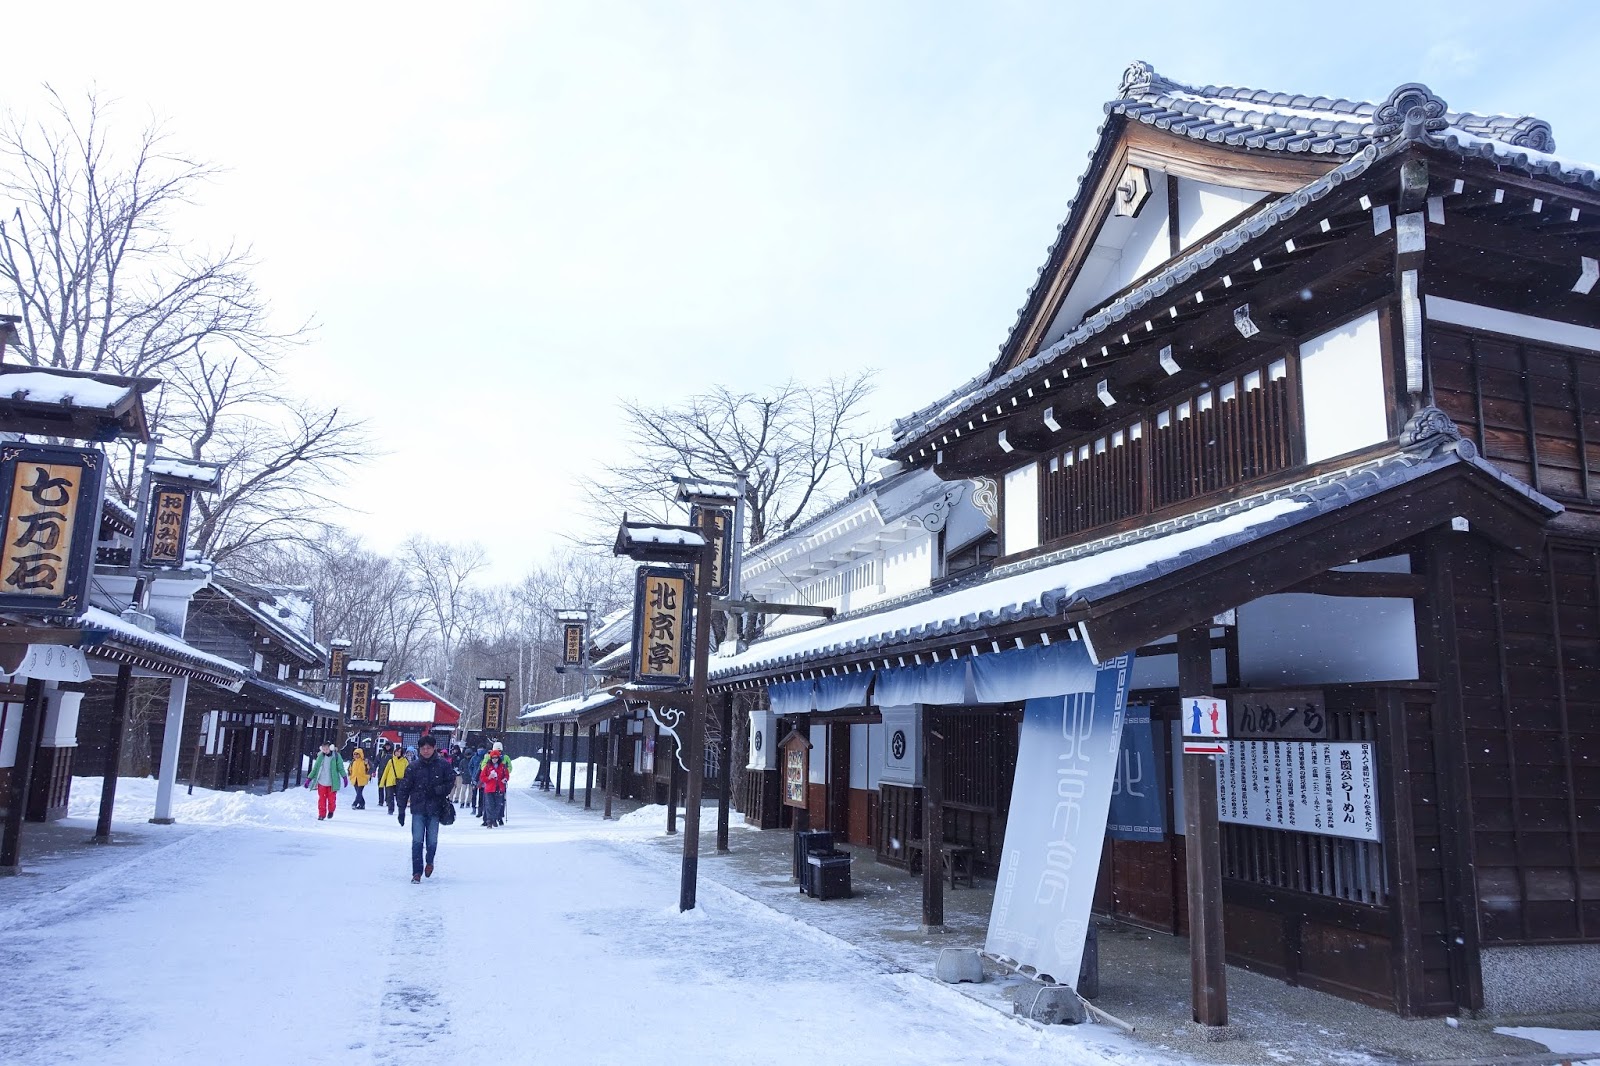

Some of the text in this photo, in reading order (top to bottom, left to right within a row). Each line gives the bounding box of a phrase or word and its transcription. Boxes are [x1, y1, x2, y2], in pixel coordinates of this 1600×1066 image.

[5, 467, 73, 591] 七万石
[153, 495, 182, 557] お休み処
[647, 582, 677, 672] 北京亭
